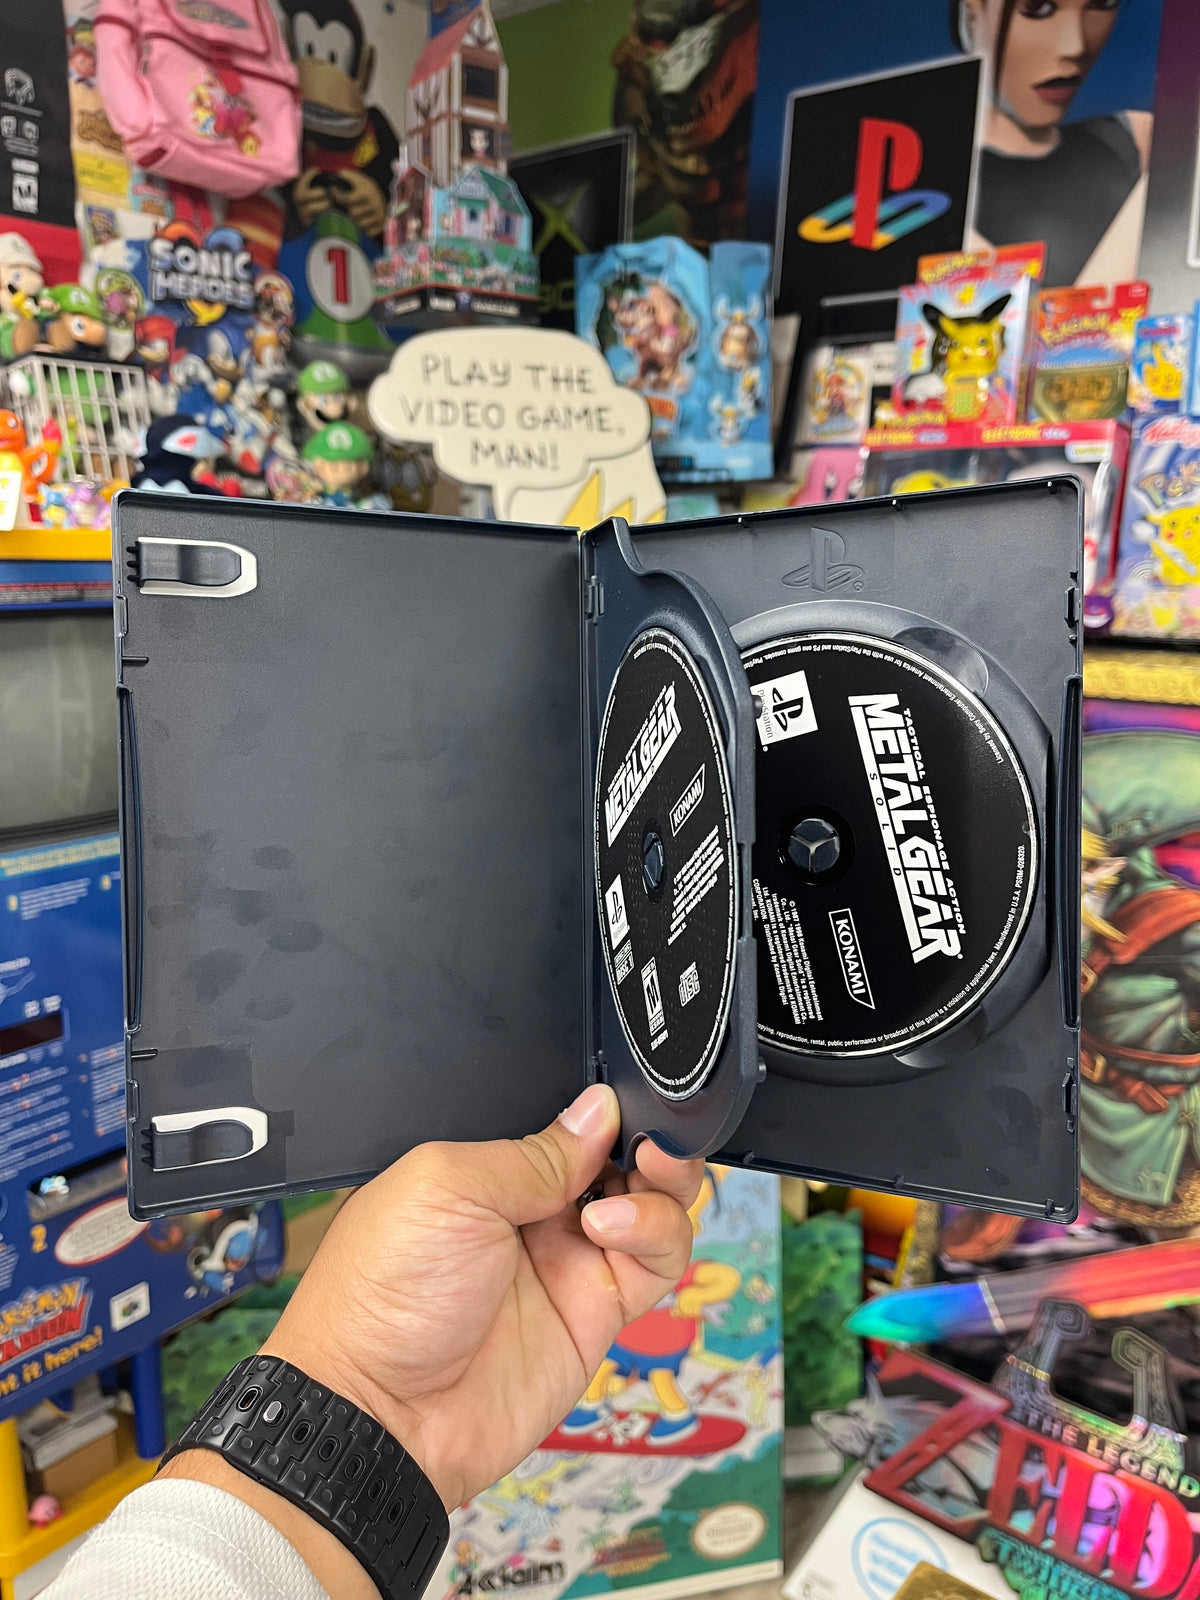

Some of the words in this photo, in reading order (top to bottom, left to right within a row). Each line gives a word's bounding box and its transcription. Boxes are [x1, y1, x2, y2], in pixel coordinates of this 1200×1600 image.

[151, 238, 252, 280] SONIC
[420, 353, 511, 388] PLAY
[523, 363, 596, 394] THE
[401, 394, 506, 430] VIDEO
[470, 439, 560, 470] MAN!
[787, 645, 801, 654] game
[894, 659, 903, 667] for
[902, 662, 924, 677] America
[922, 673, 957, 701] Entertainment
[954, 697, 977, 722] Computer
[971, 719, 986, 734] Sony
[604, 749, 643, 843] METAL
[640, 683, 682, 773] GEAR
[986, 739, 1004, 764] Licensed
[673, 778, 702, 828] KONAMI
[903, 708, 926, 779] TACTICAL
[923, 785, 951, 871] ESPIONAGE
[946, 877, 967, 935] ACTION
[848, 694, 929, 835] METAL
[899, 835, 963, 964] GEAR
[869, 772, 902, 877] SOLID
[763, 924, 776, 955] Distributed
[771, 893, 783, 922] trademark
[780, 929, 791, 951] Konami
[791, 972, 806, 1012] Entertainment
[771, 955, 777, 963] by
[798, 938, 809, 960] Konami
[836, 918, 866, 995] KONAMI
[773, 963, 784, 985] Konami
[774, 935, 786, 963] registered
[781, 964, 793, 993] trademark
[776, 1031, 809, 1043] reproduction,
[844, 1038, 877, 1047] performance
[883, 1027, 909, 1040] broadcast
[915, 1020, 926, 1028] this
[925, 1012, 939, 1024] game
[947, 990, 966, 1008] violation
[965, 984, 971, 992] of
[969, 963, 990, 987] applicable
[994, 914, 1015, 950] Manufactured
[783, 911, 791, 923] Ltd.
[803, 990, 816, 1019] registered
[803, 960, 814, 980] Digital
[646, 974, 660, 1015] M
[779, 986, 789, 1005] Digital
[808, 980, 824, 1021] Entertainment
[44, 1324, 104, 1372] here!
[1027, 1409, 1080, 1447] THE
[1086, 1435, 1200, 1499] LEGEND
